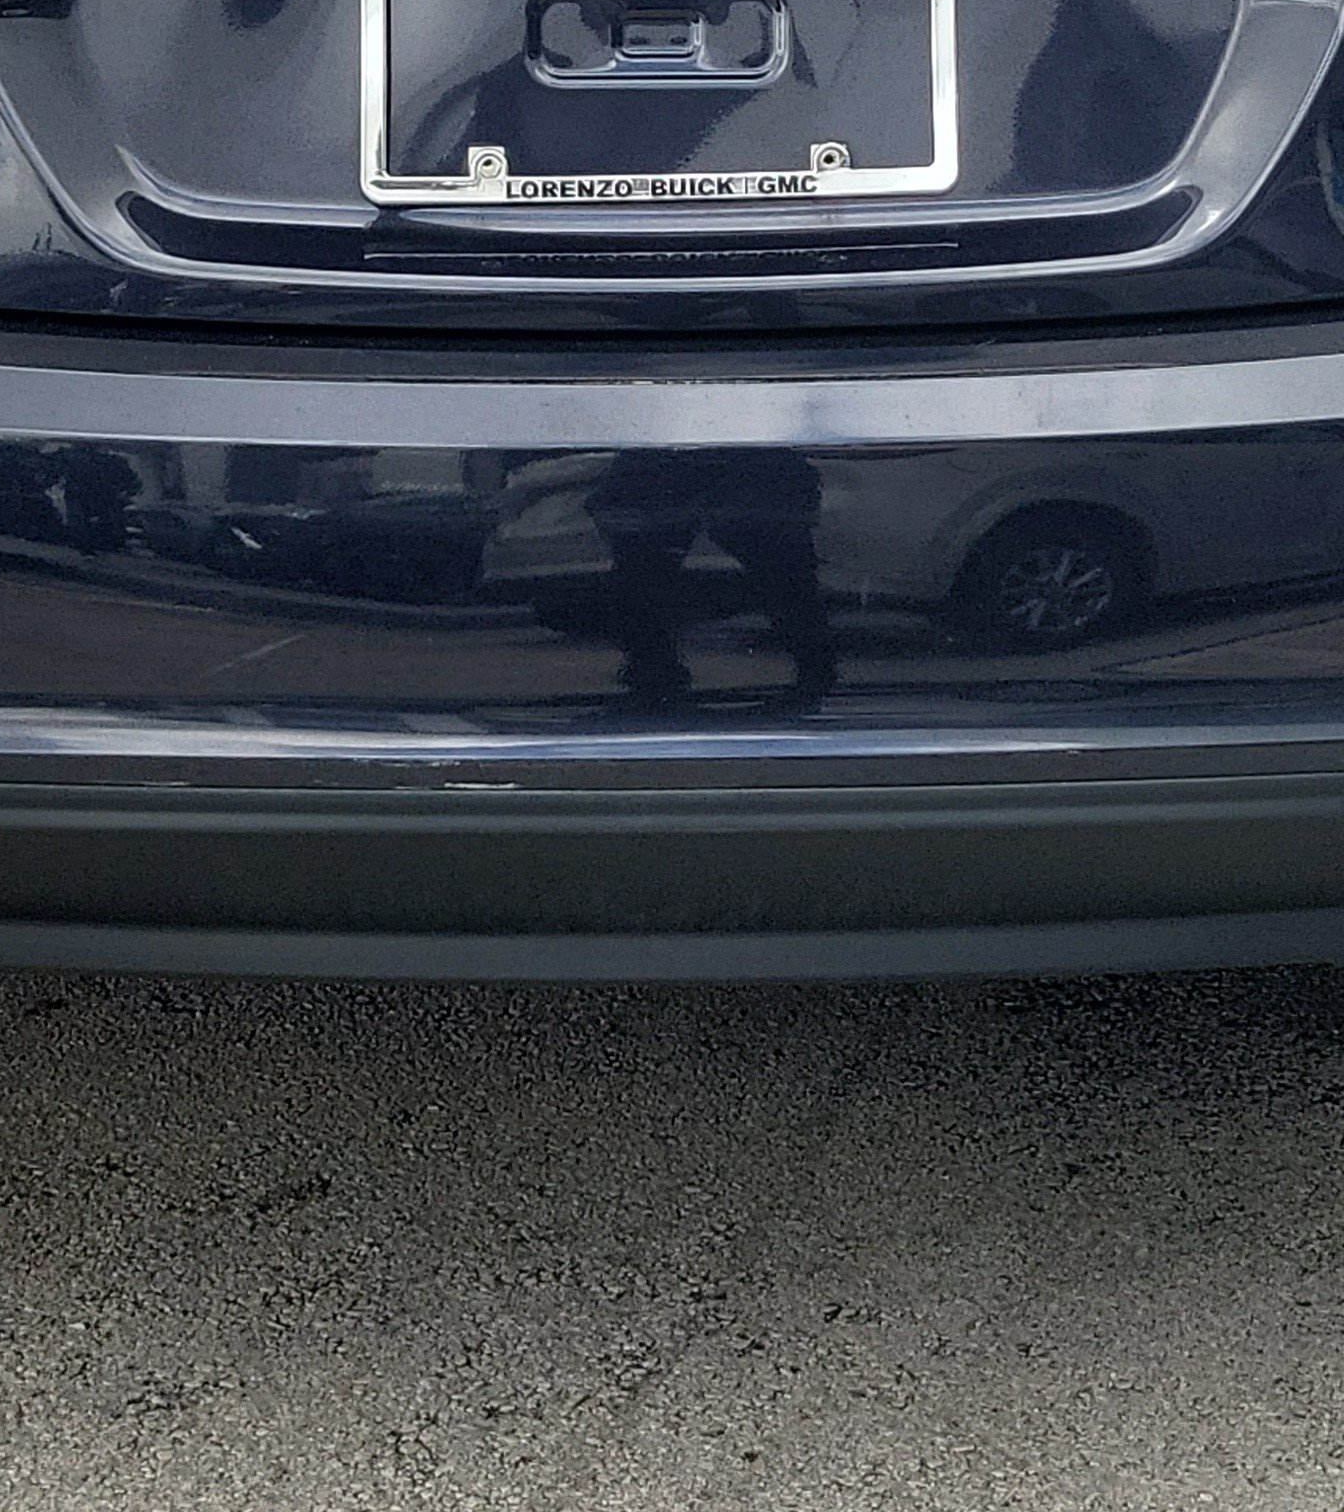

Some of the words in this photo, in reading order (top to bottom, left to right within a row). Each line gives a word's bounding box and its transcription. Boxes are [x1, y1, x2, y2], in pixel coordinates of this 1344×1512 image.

[506, 179, 634, 199] LORENZO
[650, 176, 735, 197] BUICK
[757, 174, 818, 194] GMC
